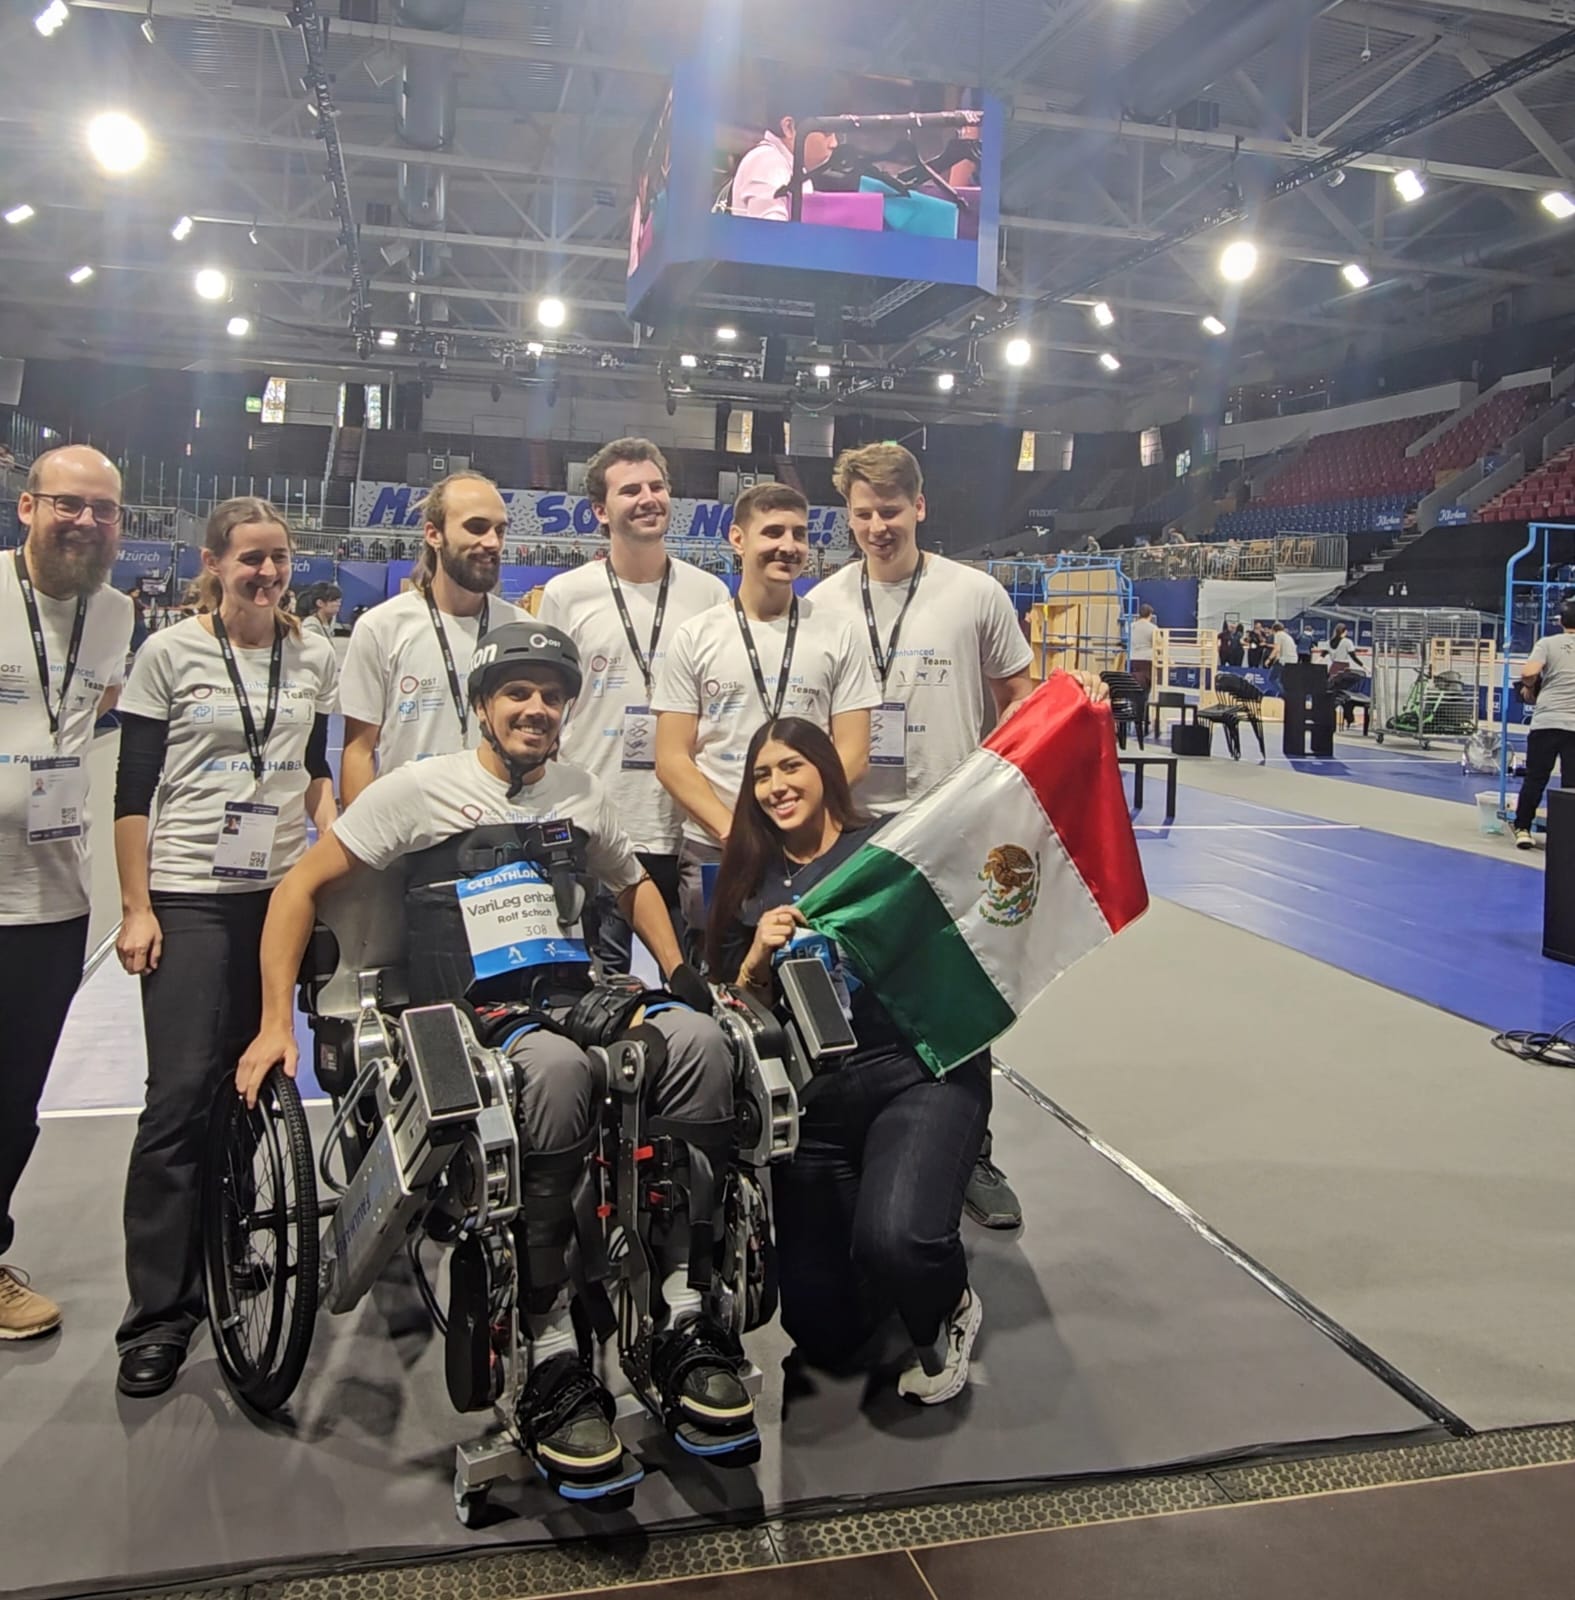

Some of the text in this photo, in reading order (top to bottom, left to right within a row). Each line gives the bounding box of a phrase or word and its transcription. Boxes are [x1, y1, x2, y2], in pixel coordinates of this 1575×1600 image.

[922, 657, 952, 666] Teams
[0, 664, 23, 673] OST
[421, 677, 437, 687] OST
[721, 681, 738, 690] OST
[467, 896, 522, 917] VariLeg
[497, 912, 519, 925] Rolf
